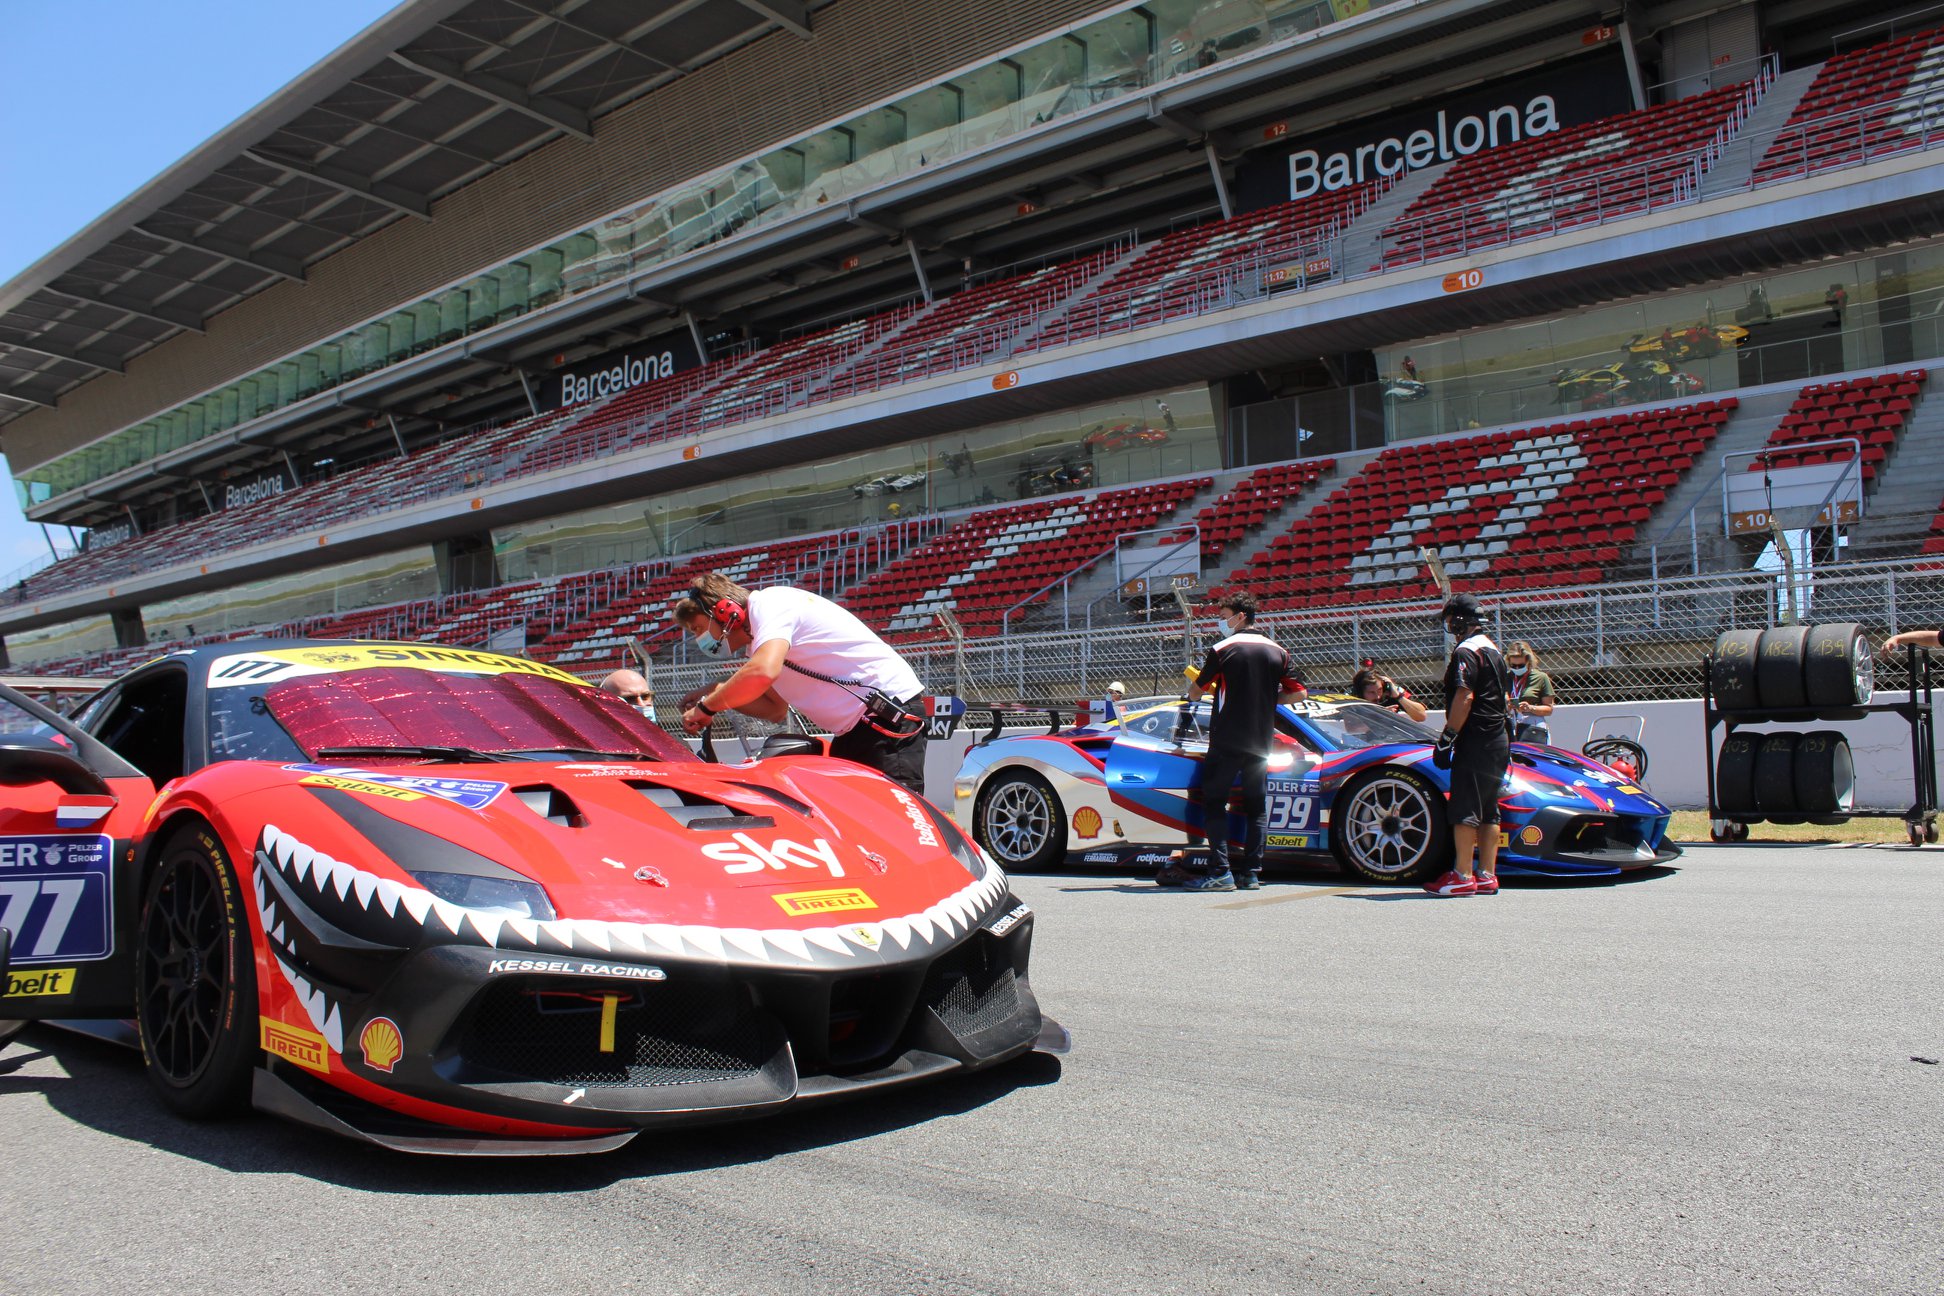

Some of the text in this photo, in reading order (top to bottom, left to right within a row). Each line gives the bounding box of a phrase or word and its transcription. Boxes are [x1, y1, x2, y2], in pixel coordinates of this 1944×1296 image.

[1594, 27, 1611, 40] 13
[1273, 124, 1286, 135] 12
[1289, 95, 1560, 201] Barcelona
[1458, 271, 1480, 288] 10
[562, 351, 674, 407] Barcelona
[1009, 374, 1017, 386] 9
[693, 446, 699, 458] 8
[226, 474, 283, 508] Barcelona
[1746, 513, 1766, 527] 10
[1137, 582, 1143, 592] 9
[1178, 577, 1189, 587] 10
[1717, 637, 1749, 657] 103
[1764, 640, 1794, 656] 182
[1814, 639, 1846, 657] 139
[215, 660, 297, 679] 177
[365, 649, 573, 682] SINGHA
[315, 777, 409, 798] Sabelt
[68, 844, 103, 852] PELZER
[1267, 835, 1303, 847] Sabelt
[68, 855, 103, 863] GROUP
[701, 832, 845, 878] sky
[210, 850, 235, 925] PIRELLI
[784, 892, 867, 911] PIRELLI
[488, 959, 665, 978] KESSEL RACING
[265, 1026, 322, 1065] PIRELLI
